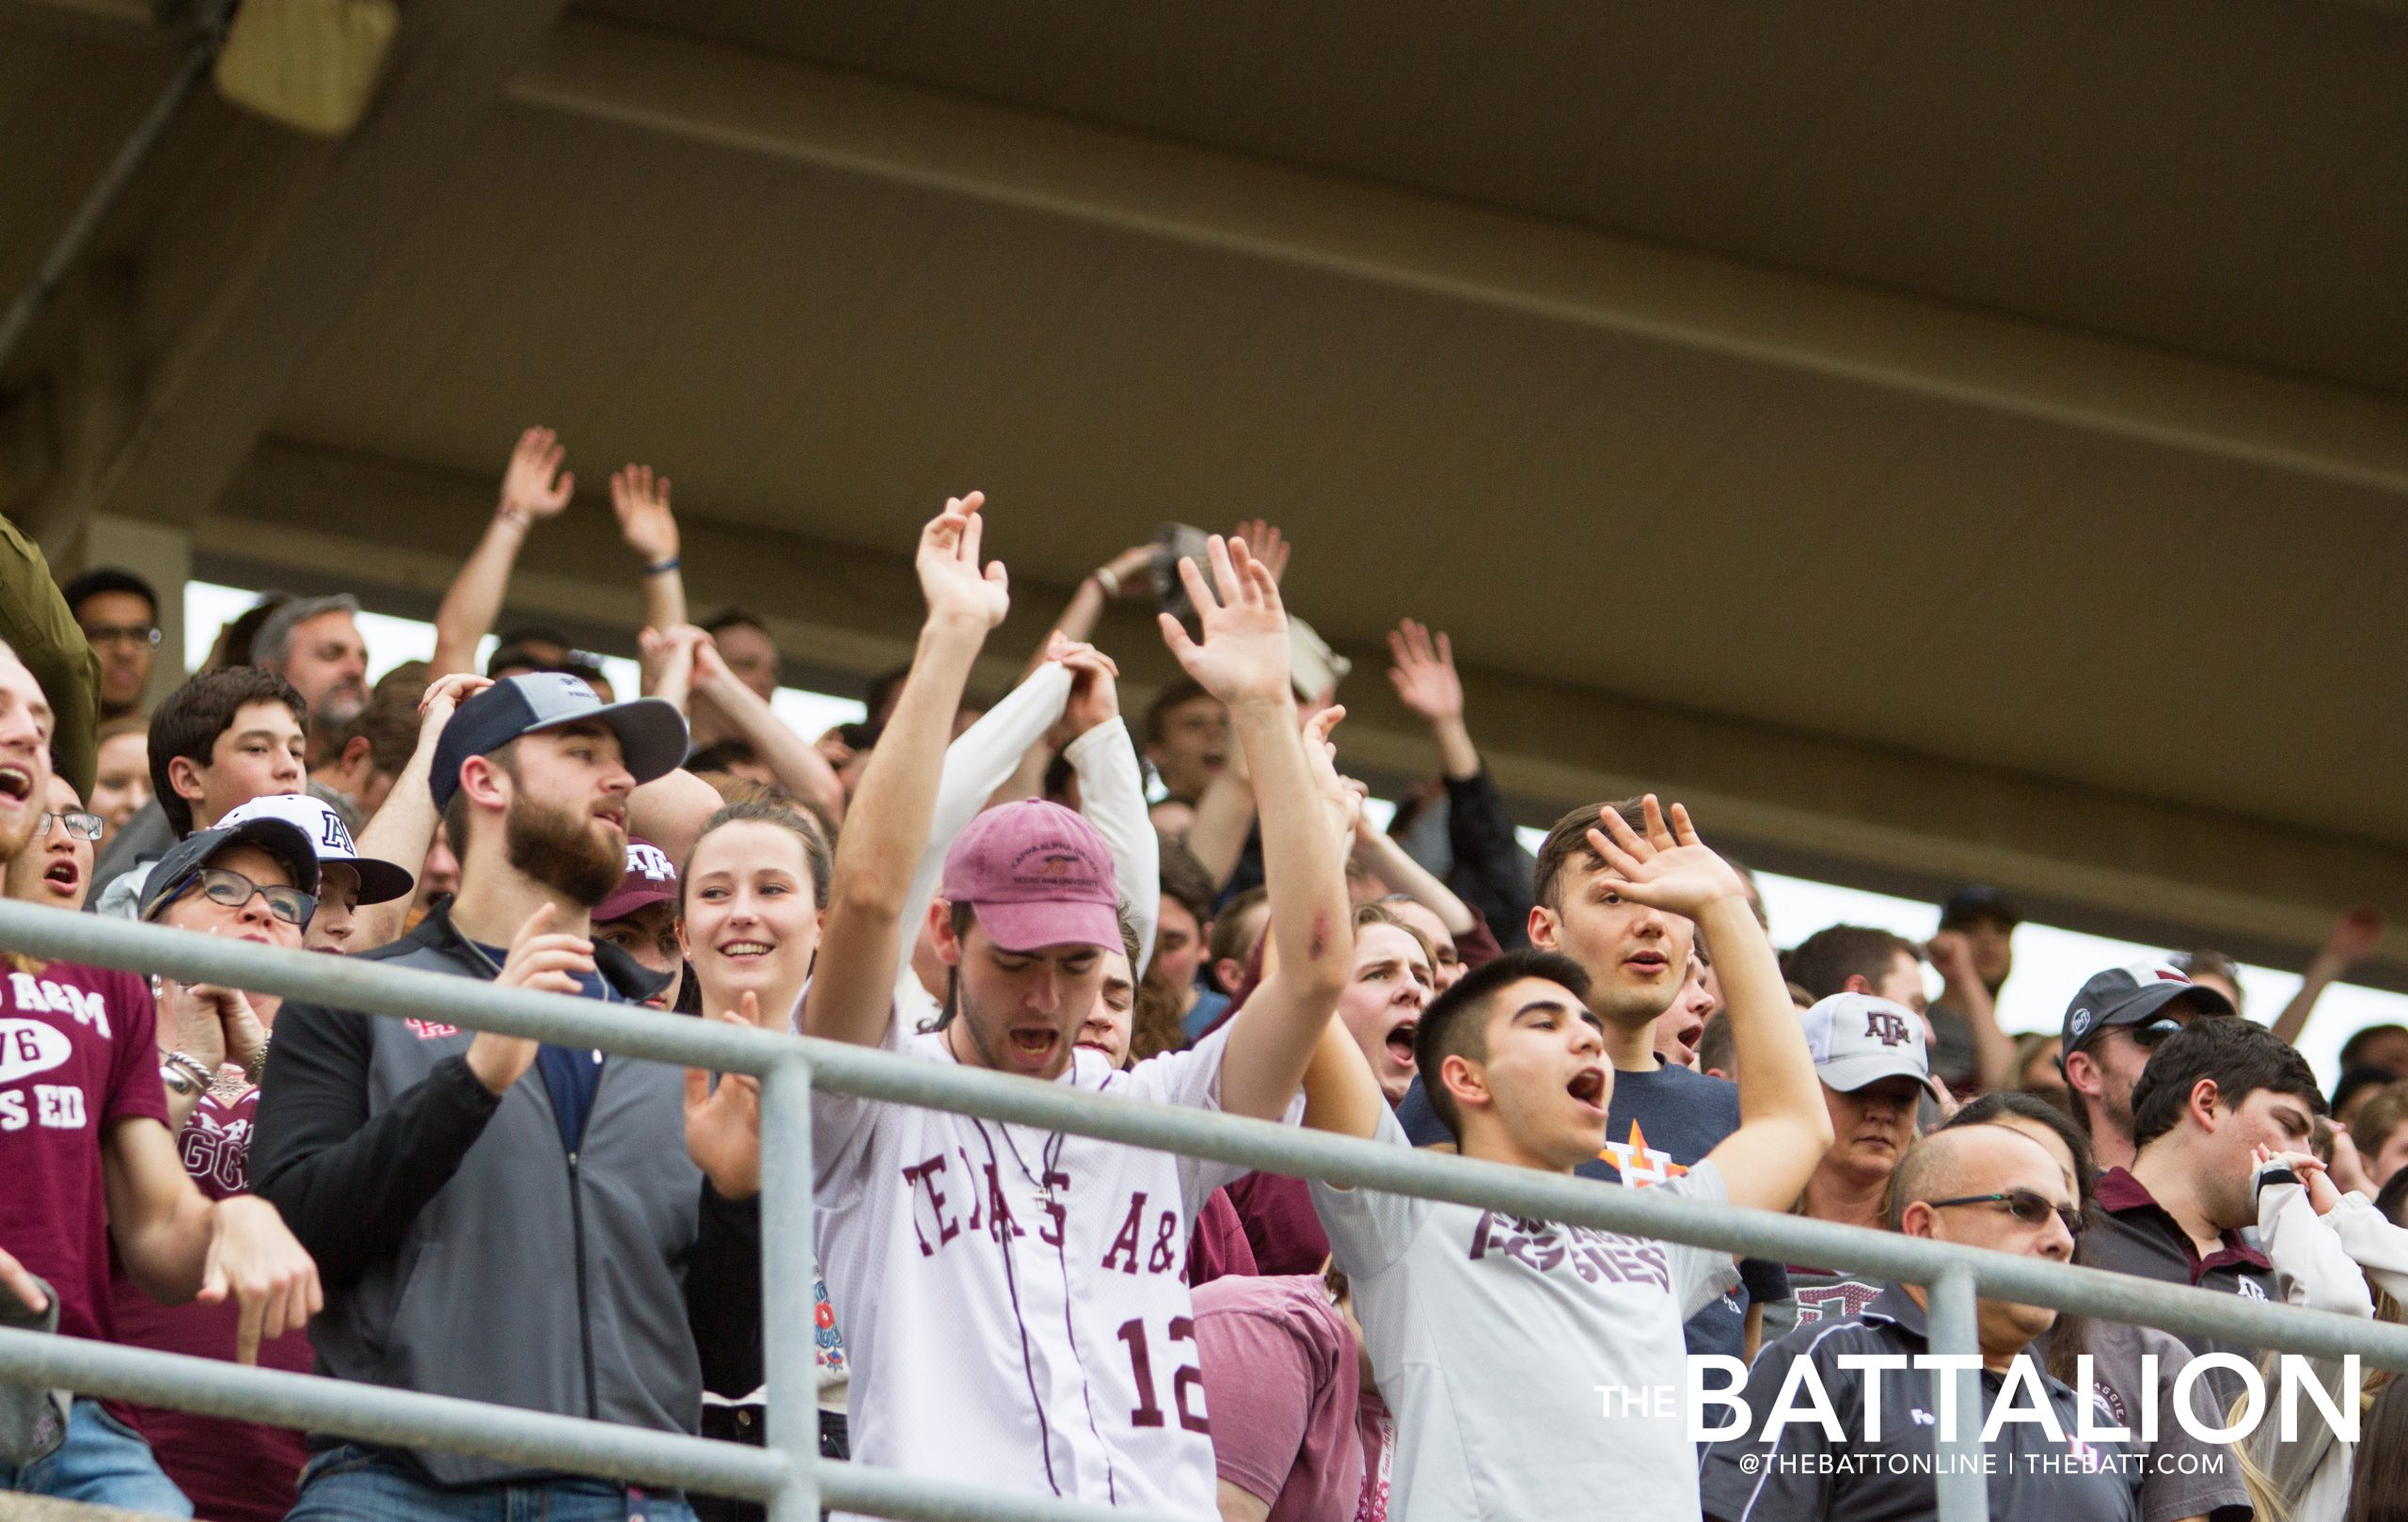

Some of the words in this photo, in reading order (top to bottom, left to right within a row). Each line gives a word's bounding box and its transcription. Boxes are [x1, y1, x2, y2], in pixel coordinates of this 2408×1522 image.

[8, 972, 113, 1039] A&M
[0, 1027, 41, 1067] 6
[33, 1084, 87, 1129] ED
[1101, 1191, 1187, 1285] A&
[1117, 1317, 1211, 1435] 12
